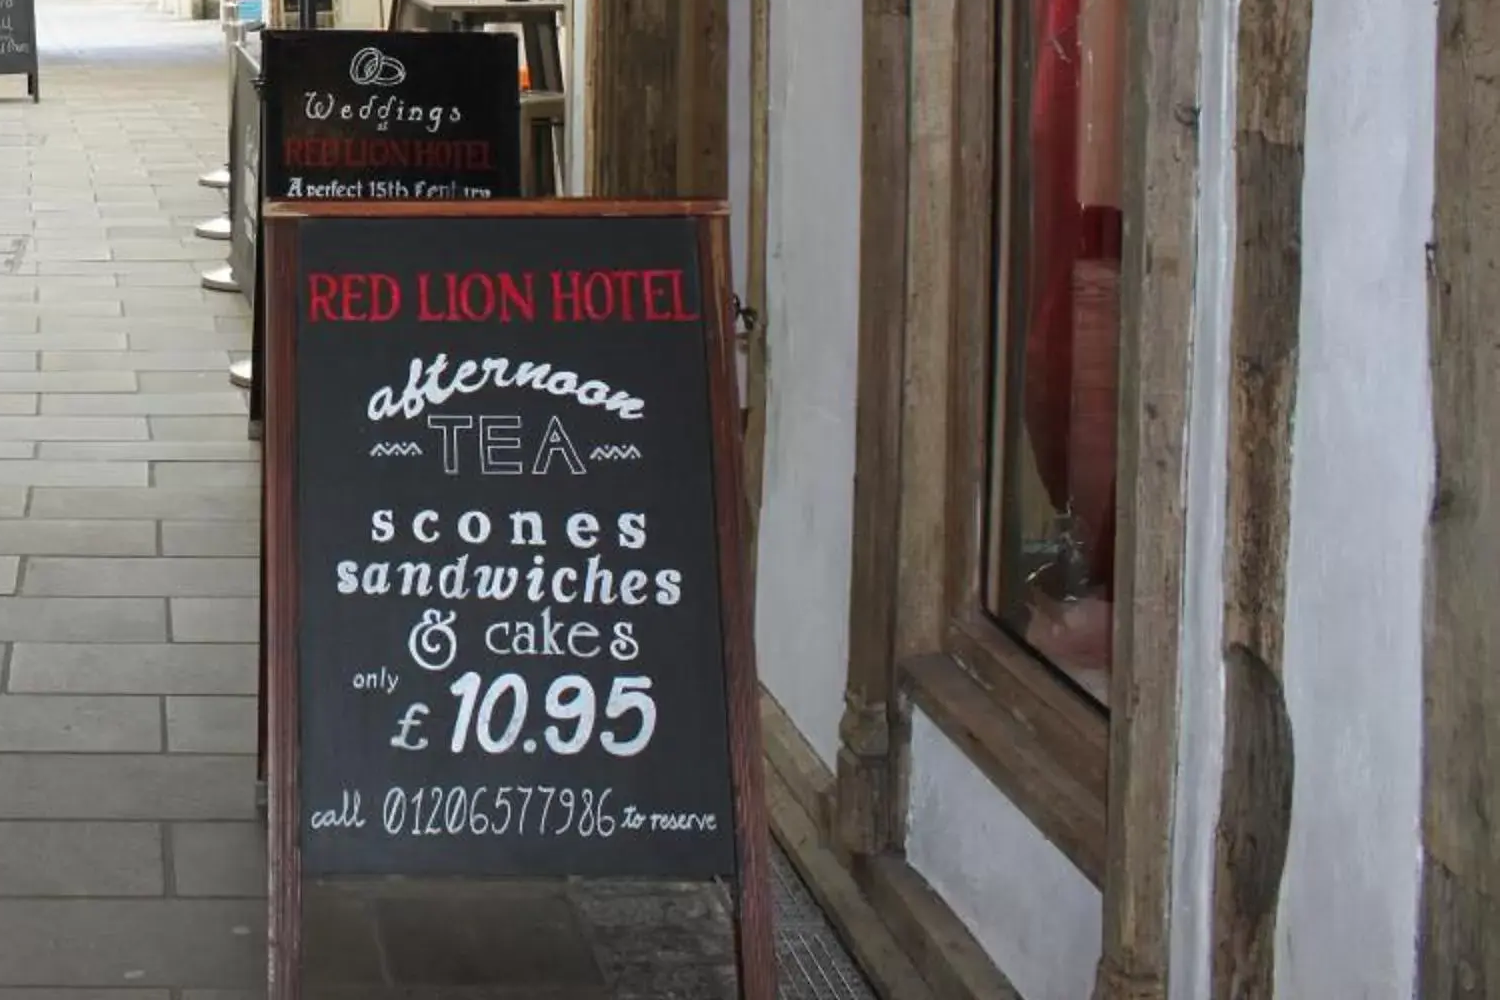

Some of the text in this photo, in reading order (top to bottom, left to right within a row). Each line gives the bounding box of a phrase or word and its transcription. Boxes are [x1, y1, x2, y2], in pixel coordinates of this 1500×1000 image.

[305, 91, 461, 133] Weddings
[285, 138, 495, 172] RED LION HOTEL
[287, 177, 303, 198] A
[305, 179, 363, 198] perfect
[369, 179, 409, 198] 15th
[309, 269, 698, 323] RED LION HOTEL
[367, 353, 645, 421] afternoon
[427, 415, 587, 475] TEA
[371, 509, 647, 549] scones
[336, 553, 682, 606] sandwiches
[408, 606, 640, 670] & cakes
[352, 666, 399, 695] only
[390, 671, 657, 757] £ 10.95
[310, 785, 717, 838] call 01206577986 to reserve
